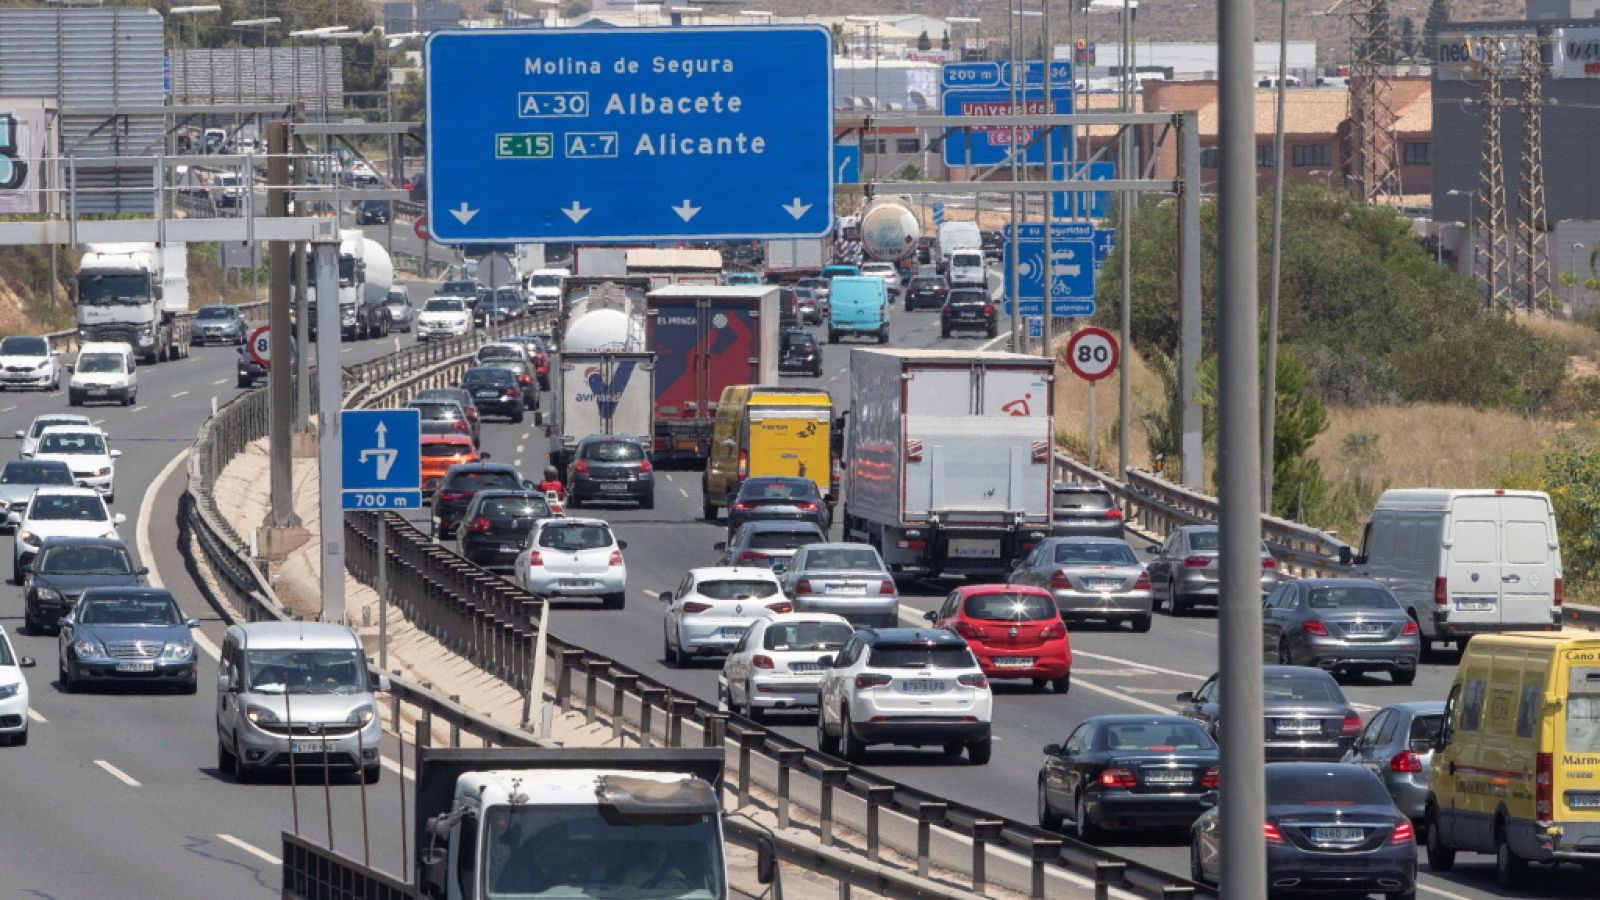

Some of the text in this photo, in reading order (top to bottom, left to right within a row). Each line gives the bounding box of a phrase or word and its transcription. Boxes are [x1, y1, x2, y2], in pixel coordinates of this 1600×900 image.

[524, 56, 734, 78] Molina de Segura
[949, 70, 992, 80] 200 m
[523, 92, 742, 115] A-30 Albacete
[498, 133, 766, 156] E-15 A-7 Alicante
[257, 338, 268, 352] 8
[1078, 345, 1108, 363] 80
[354, 494, 407, 507] 700 m
[1565, 651, 1595, 660] Cano
